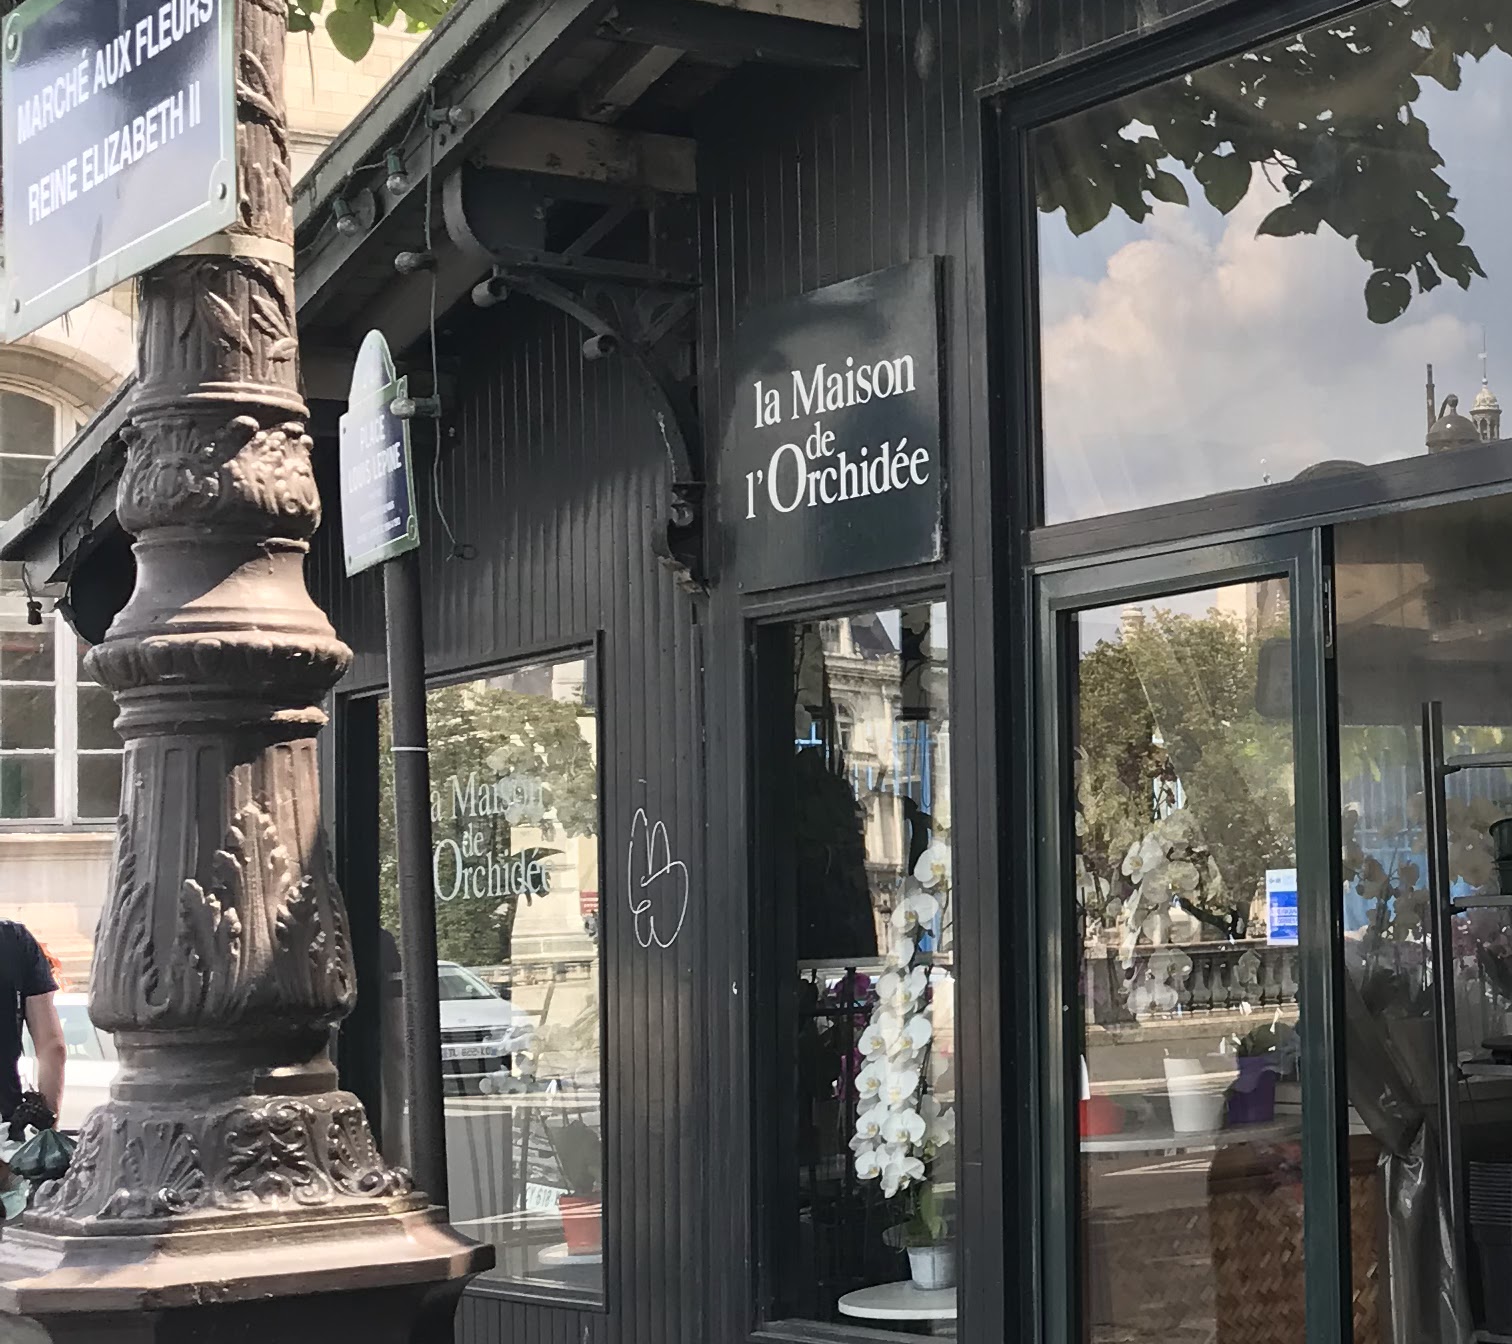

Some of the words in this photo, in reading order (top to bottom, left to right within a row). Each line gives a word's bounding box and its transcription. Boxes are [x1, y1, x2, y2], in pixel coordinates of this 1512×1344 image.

[17, 49, 90, 145] MARCHÉ
[93, 30, 132, 94] AUX
[28, 158, 78, 226] REINE
[82, 90, 184, 192] ELIZABETH
[189, 80, 201, 128] II
[754, 381, 781, 429] la
[791, 354, 915, 420] Maison
[360, 414, 386, 451] PLACE
[806, 420, 836, 459] de
[430, 789, 443, 823] a
[462, 823, 486, 858] de
